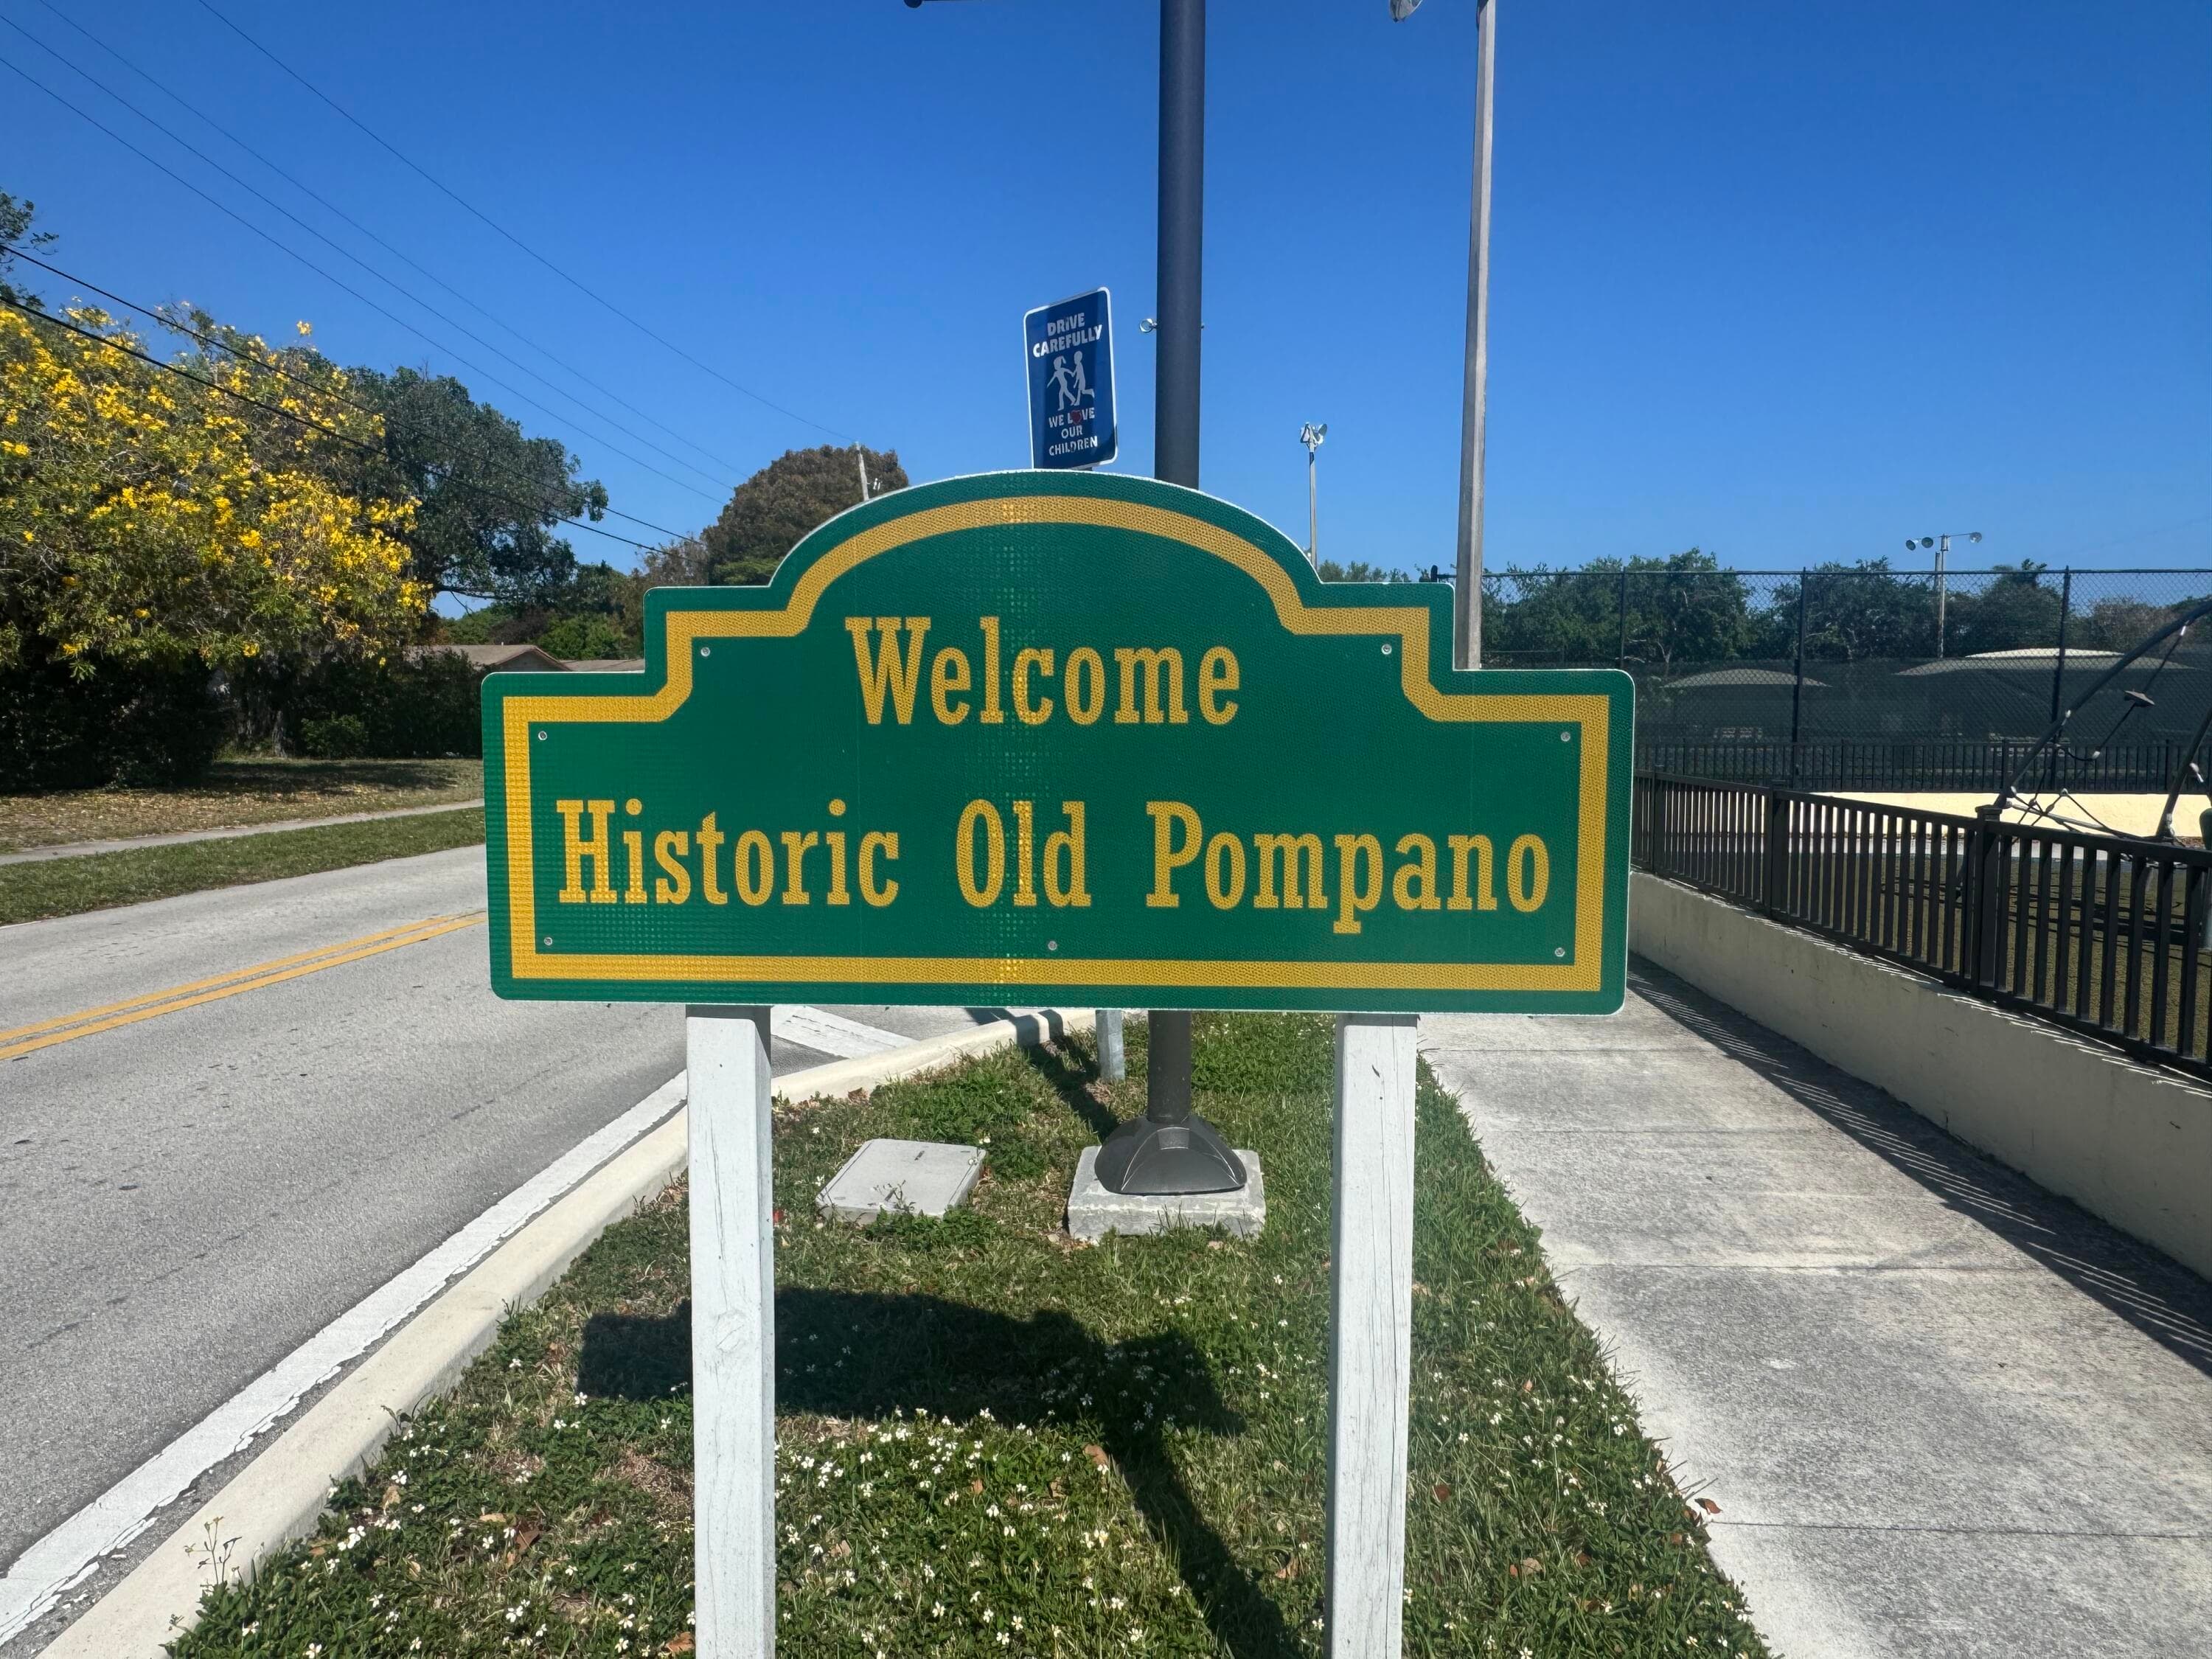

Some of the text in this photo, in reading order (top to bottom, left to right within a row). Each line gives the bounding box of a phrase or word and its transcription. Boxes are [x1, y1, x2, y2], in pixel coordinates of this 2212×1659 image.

[1033, 324, 1102, 358] CAREFULLY
[1048, 414, 1064, 428] WE
[1061, 425, 1082, 439] OUR
[1048, 436, 1098, 456] CHILDREN
[844, 616, 1240, 726] Welcome
[556, 799, 1551, 934] Historic Old Pompano
